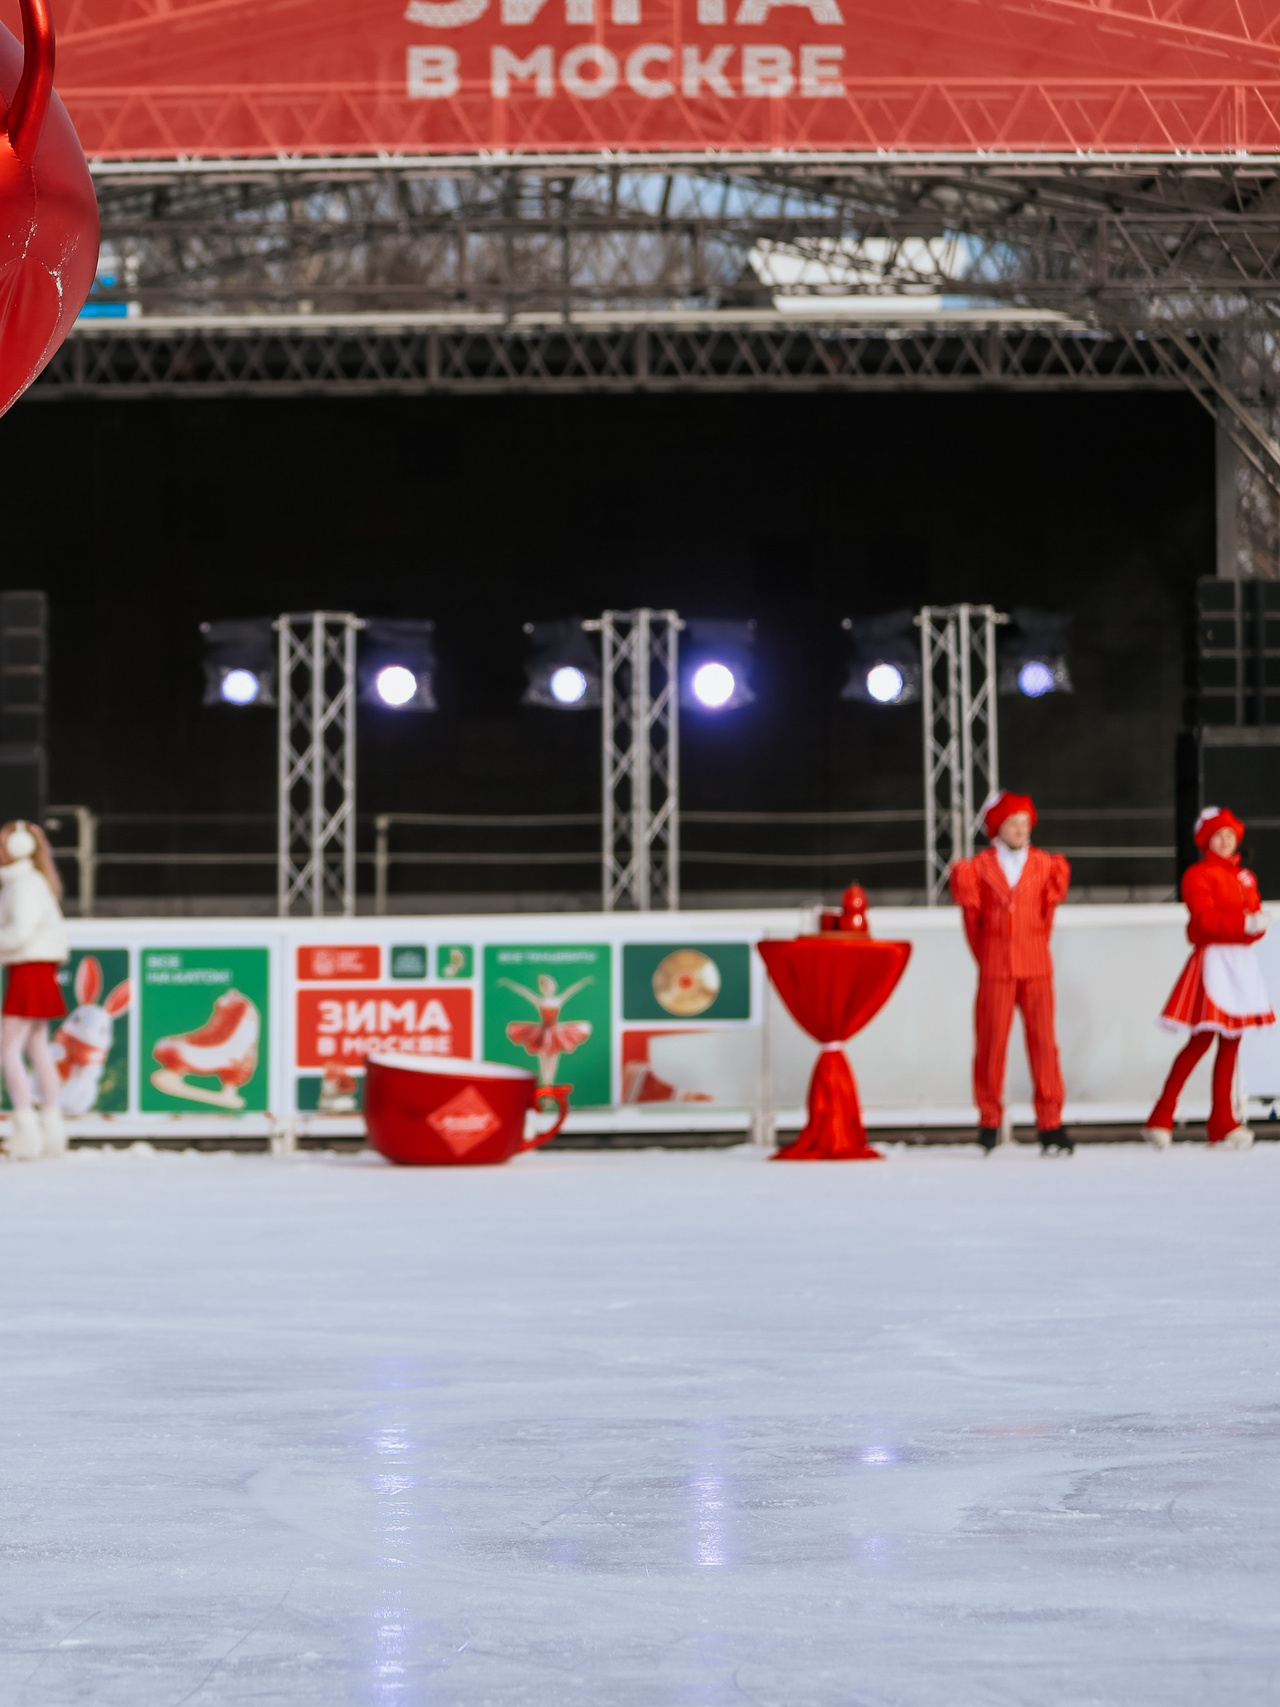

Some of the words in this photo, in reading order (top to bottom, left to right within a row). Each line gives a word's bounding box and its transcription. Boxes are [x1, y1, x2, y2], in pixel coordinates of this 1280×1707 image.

[406, 44, 461, 99] В
[490, 42, 846, 99] МОСКВЕ
[317, 999, 452, 1033] ЗИМА
[316, 1036, 337, 1056] В
[342, 1035, 452, 1056] МОСКВЕ
